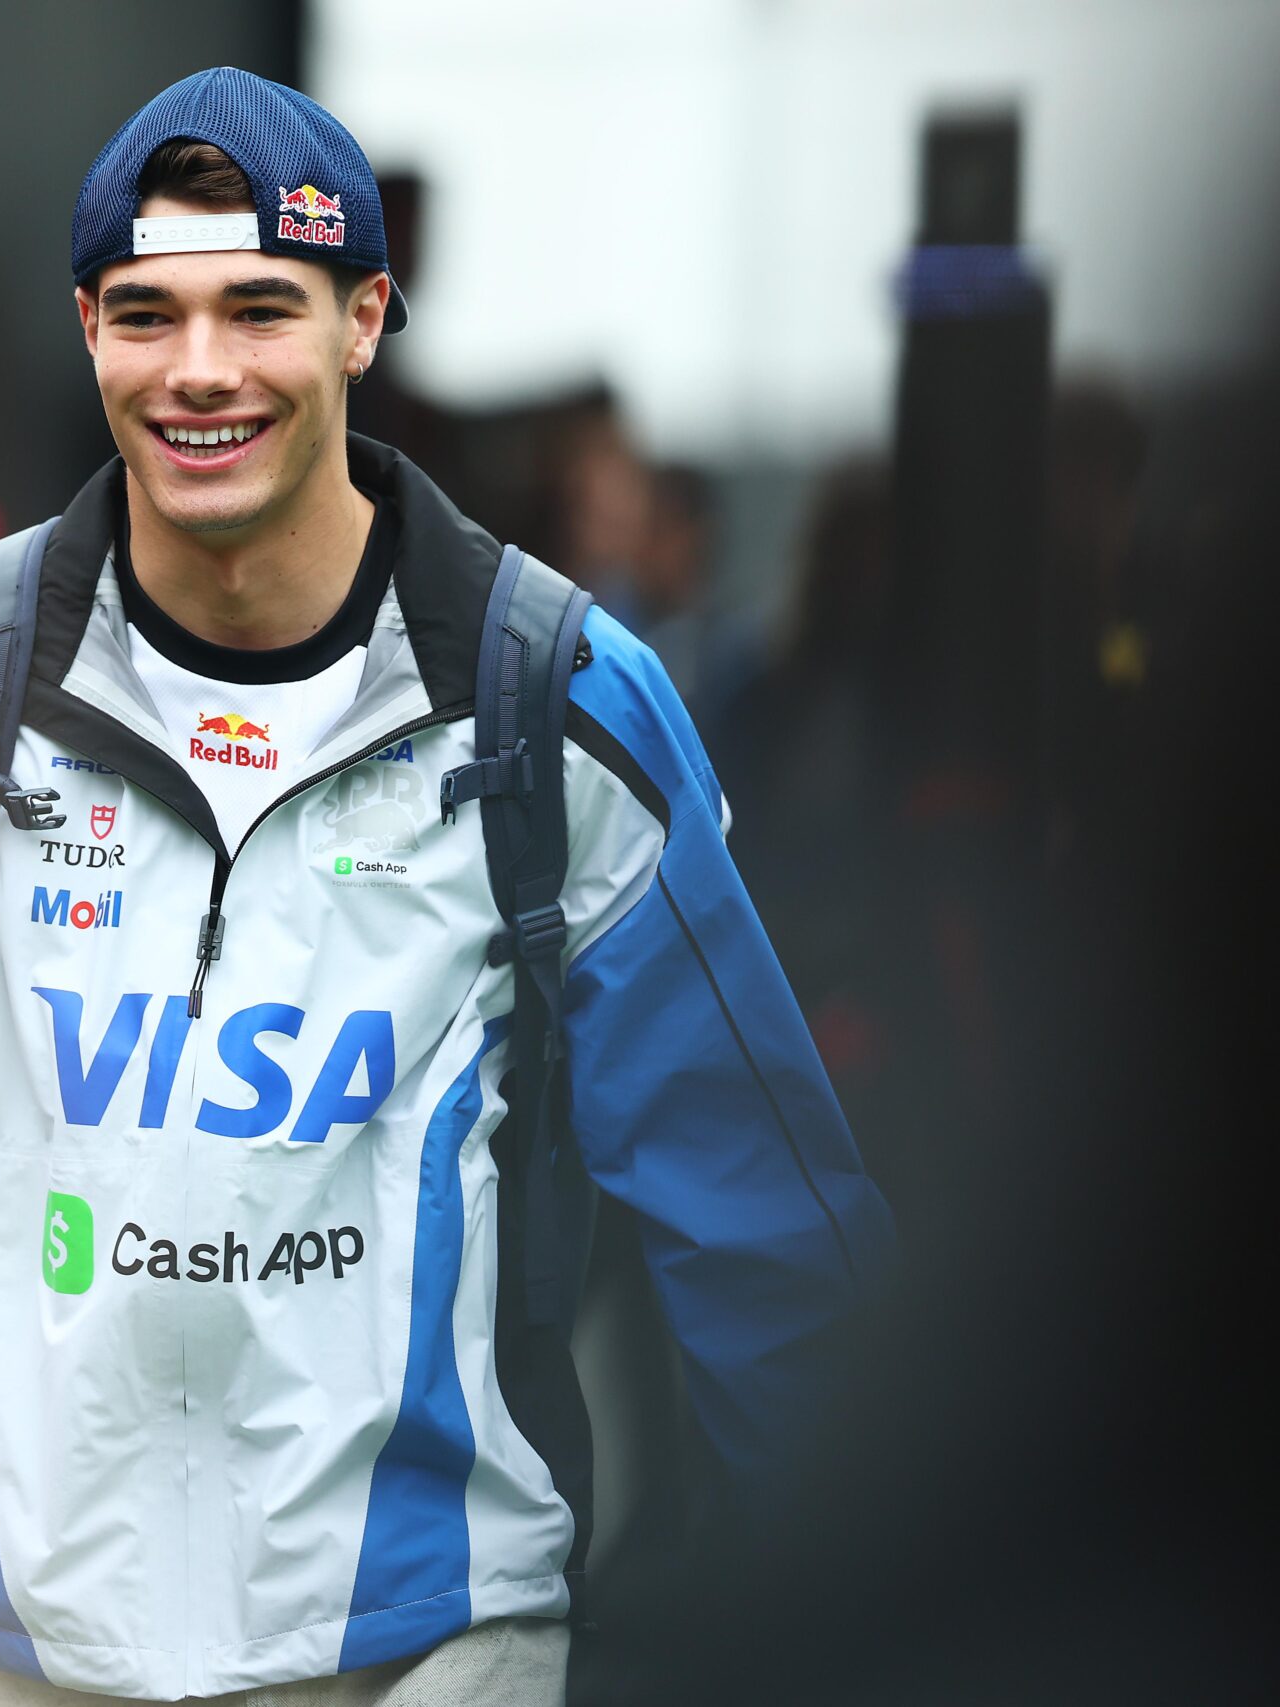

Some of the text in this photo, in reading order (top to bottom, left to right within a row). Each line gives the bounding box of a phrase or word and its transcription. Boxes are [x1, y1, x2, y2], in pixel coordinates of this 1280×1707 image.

[279, 216, 344, 245] Red Bull
[189, 738, 278, 770] Red Bull
[356, 861, 383, 872] Cash
[385, 863, 407, 875] App
[31, 886, 123, 930] Mobil
[31, 987, 396, 1143] VISA
[112, 1222, 249, 1283] Cash
[258, 1225, 364, 1285] App
